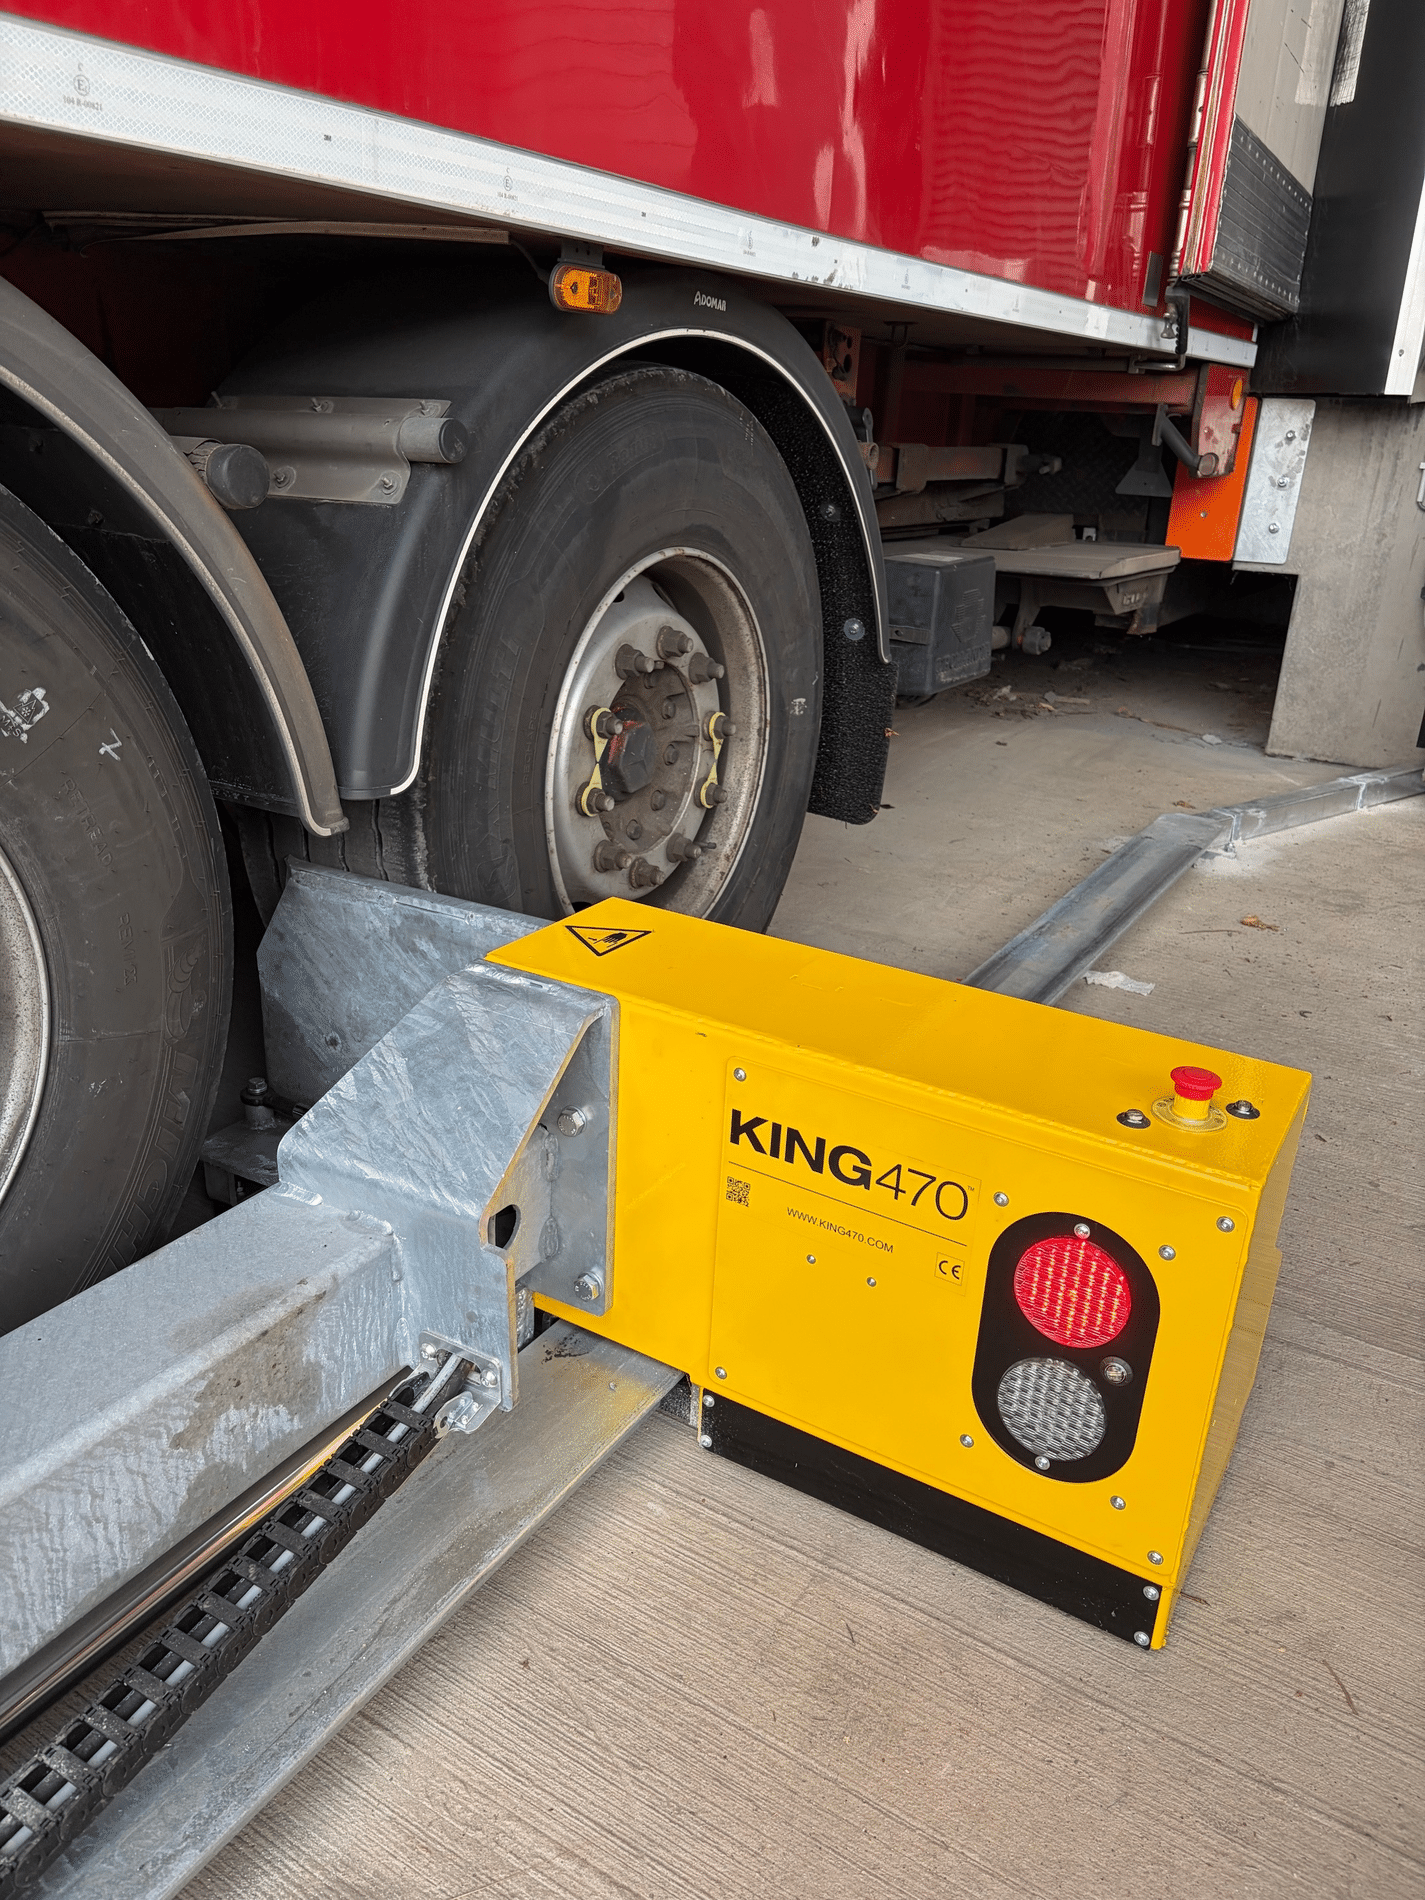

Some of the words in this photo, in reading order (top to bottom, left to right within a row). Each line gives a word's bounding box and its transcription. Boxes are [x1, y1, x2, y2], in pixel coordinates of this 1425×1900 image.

[693, 290, 728, 312] ADOMAR
[61, 777, 113, 867] RETREAD
[730, 1108, 969, 1221] KING470
[786, 1206, 894, 1253] WWW.KING470.COM
